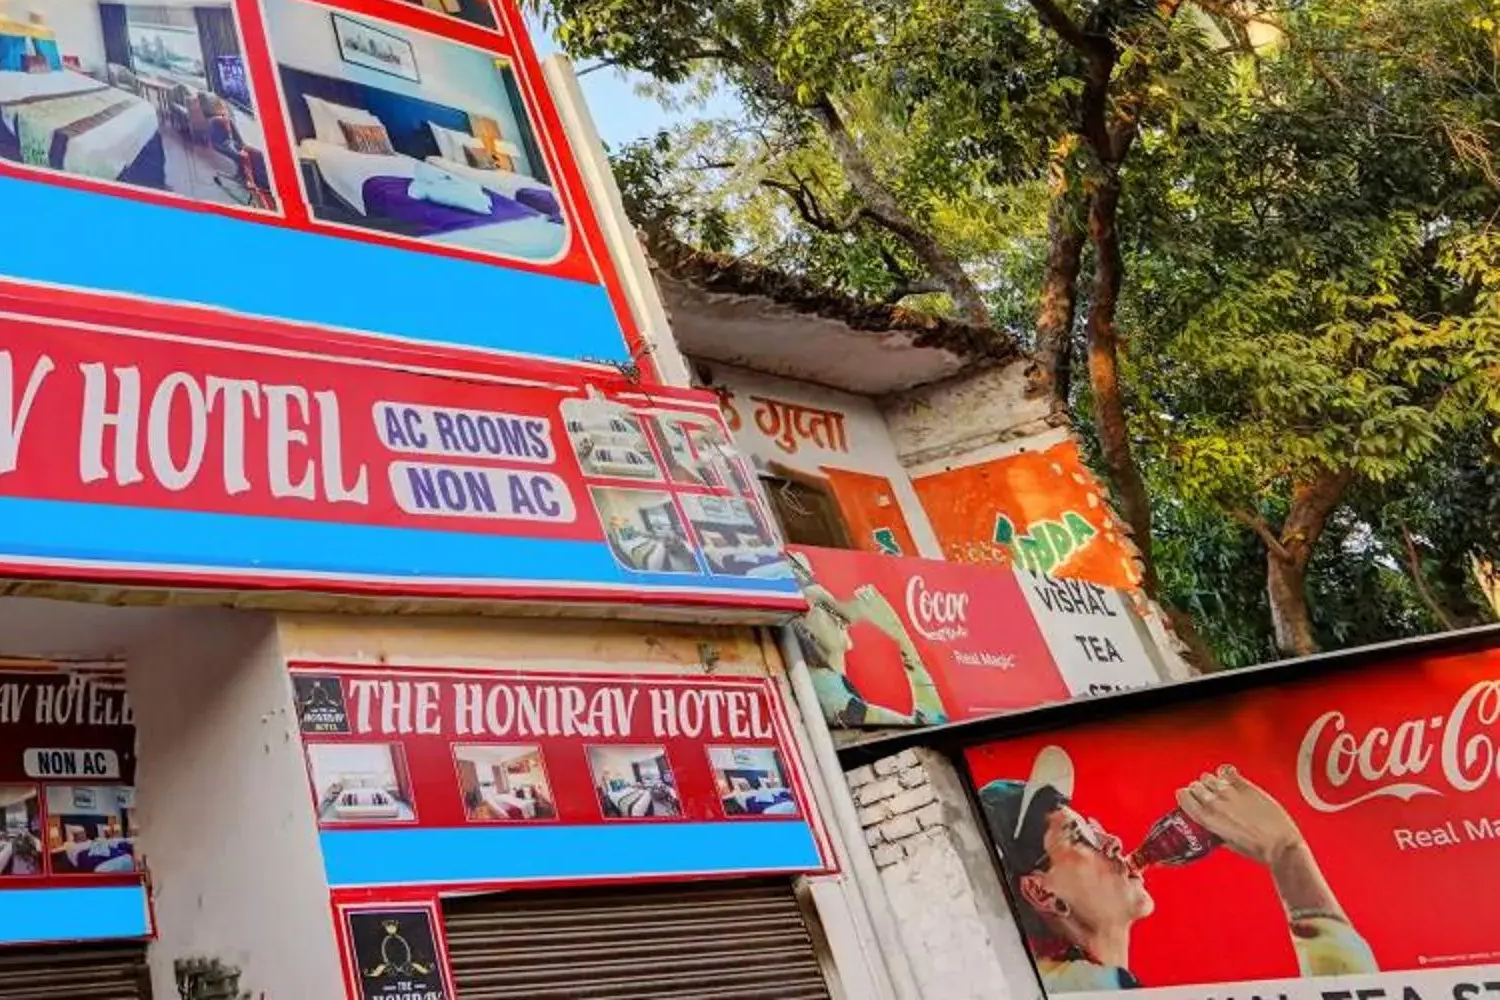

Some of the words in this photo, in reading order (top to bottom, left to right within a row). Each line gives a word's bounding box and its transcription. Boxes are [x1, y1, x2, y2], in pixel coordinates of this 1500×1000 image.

[78, 361, 369, 505] HOTEL
[384, 408, 429, 449] AC
[436, 410, 549, 462] ROOMS
[750, 396, 849, 454] गुप्ता
[407, 466, 500, 513] NON
[508, 472, 561, 516] AC
[1075, 634, 1124, 663] TEA
[349, 679, 442, 734] THE
[452, 682, 639, 738] HONIRAV
[650, 685, 773, 739] HOTEL
[38, 751, 76, 775] NON
[83, 751, 107, 775] AC
[1393, 822, 1461, 850] Real
